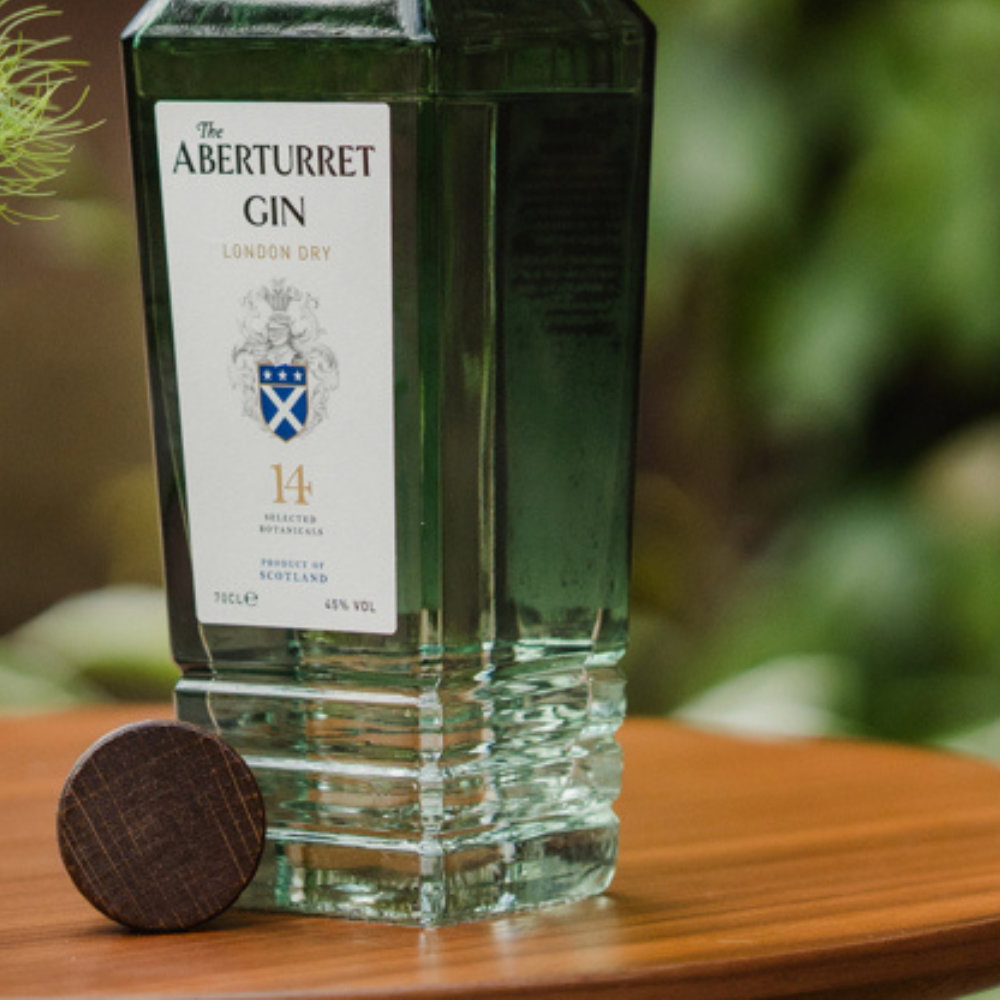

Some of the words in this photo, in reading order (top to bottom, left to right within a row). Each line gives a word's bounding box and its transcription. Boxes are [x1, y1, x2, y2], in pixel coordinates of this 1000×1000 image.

[195, 120, 225, 139] The
[173, 140, 376, 177] ABERTURRET
[243, 194, 306, 227] GIN
[223, 243, 291, 260] LONDON
[298, 245, 331, 261] DRY
[270, 463, 313, 505] 14
[264, 513, 317, 524] SELECTED
[259, 525, 324, 536] BOTANICALS
[261, 558, 308, 569] PRODUCT
[312, 560, 325, 570] OF
[259, 571, 329, 584] SCOTLAND
[353, 601, 376, 614] VOL
